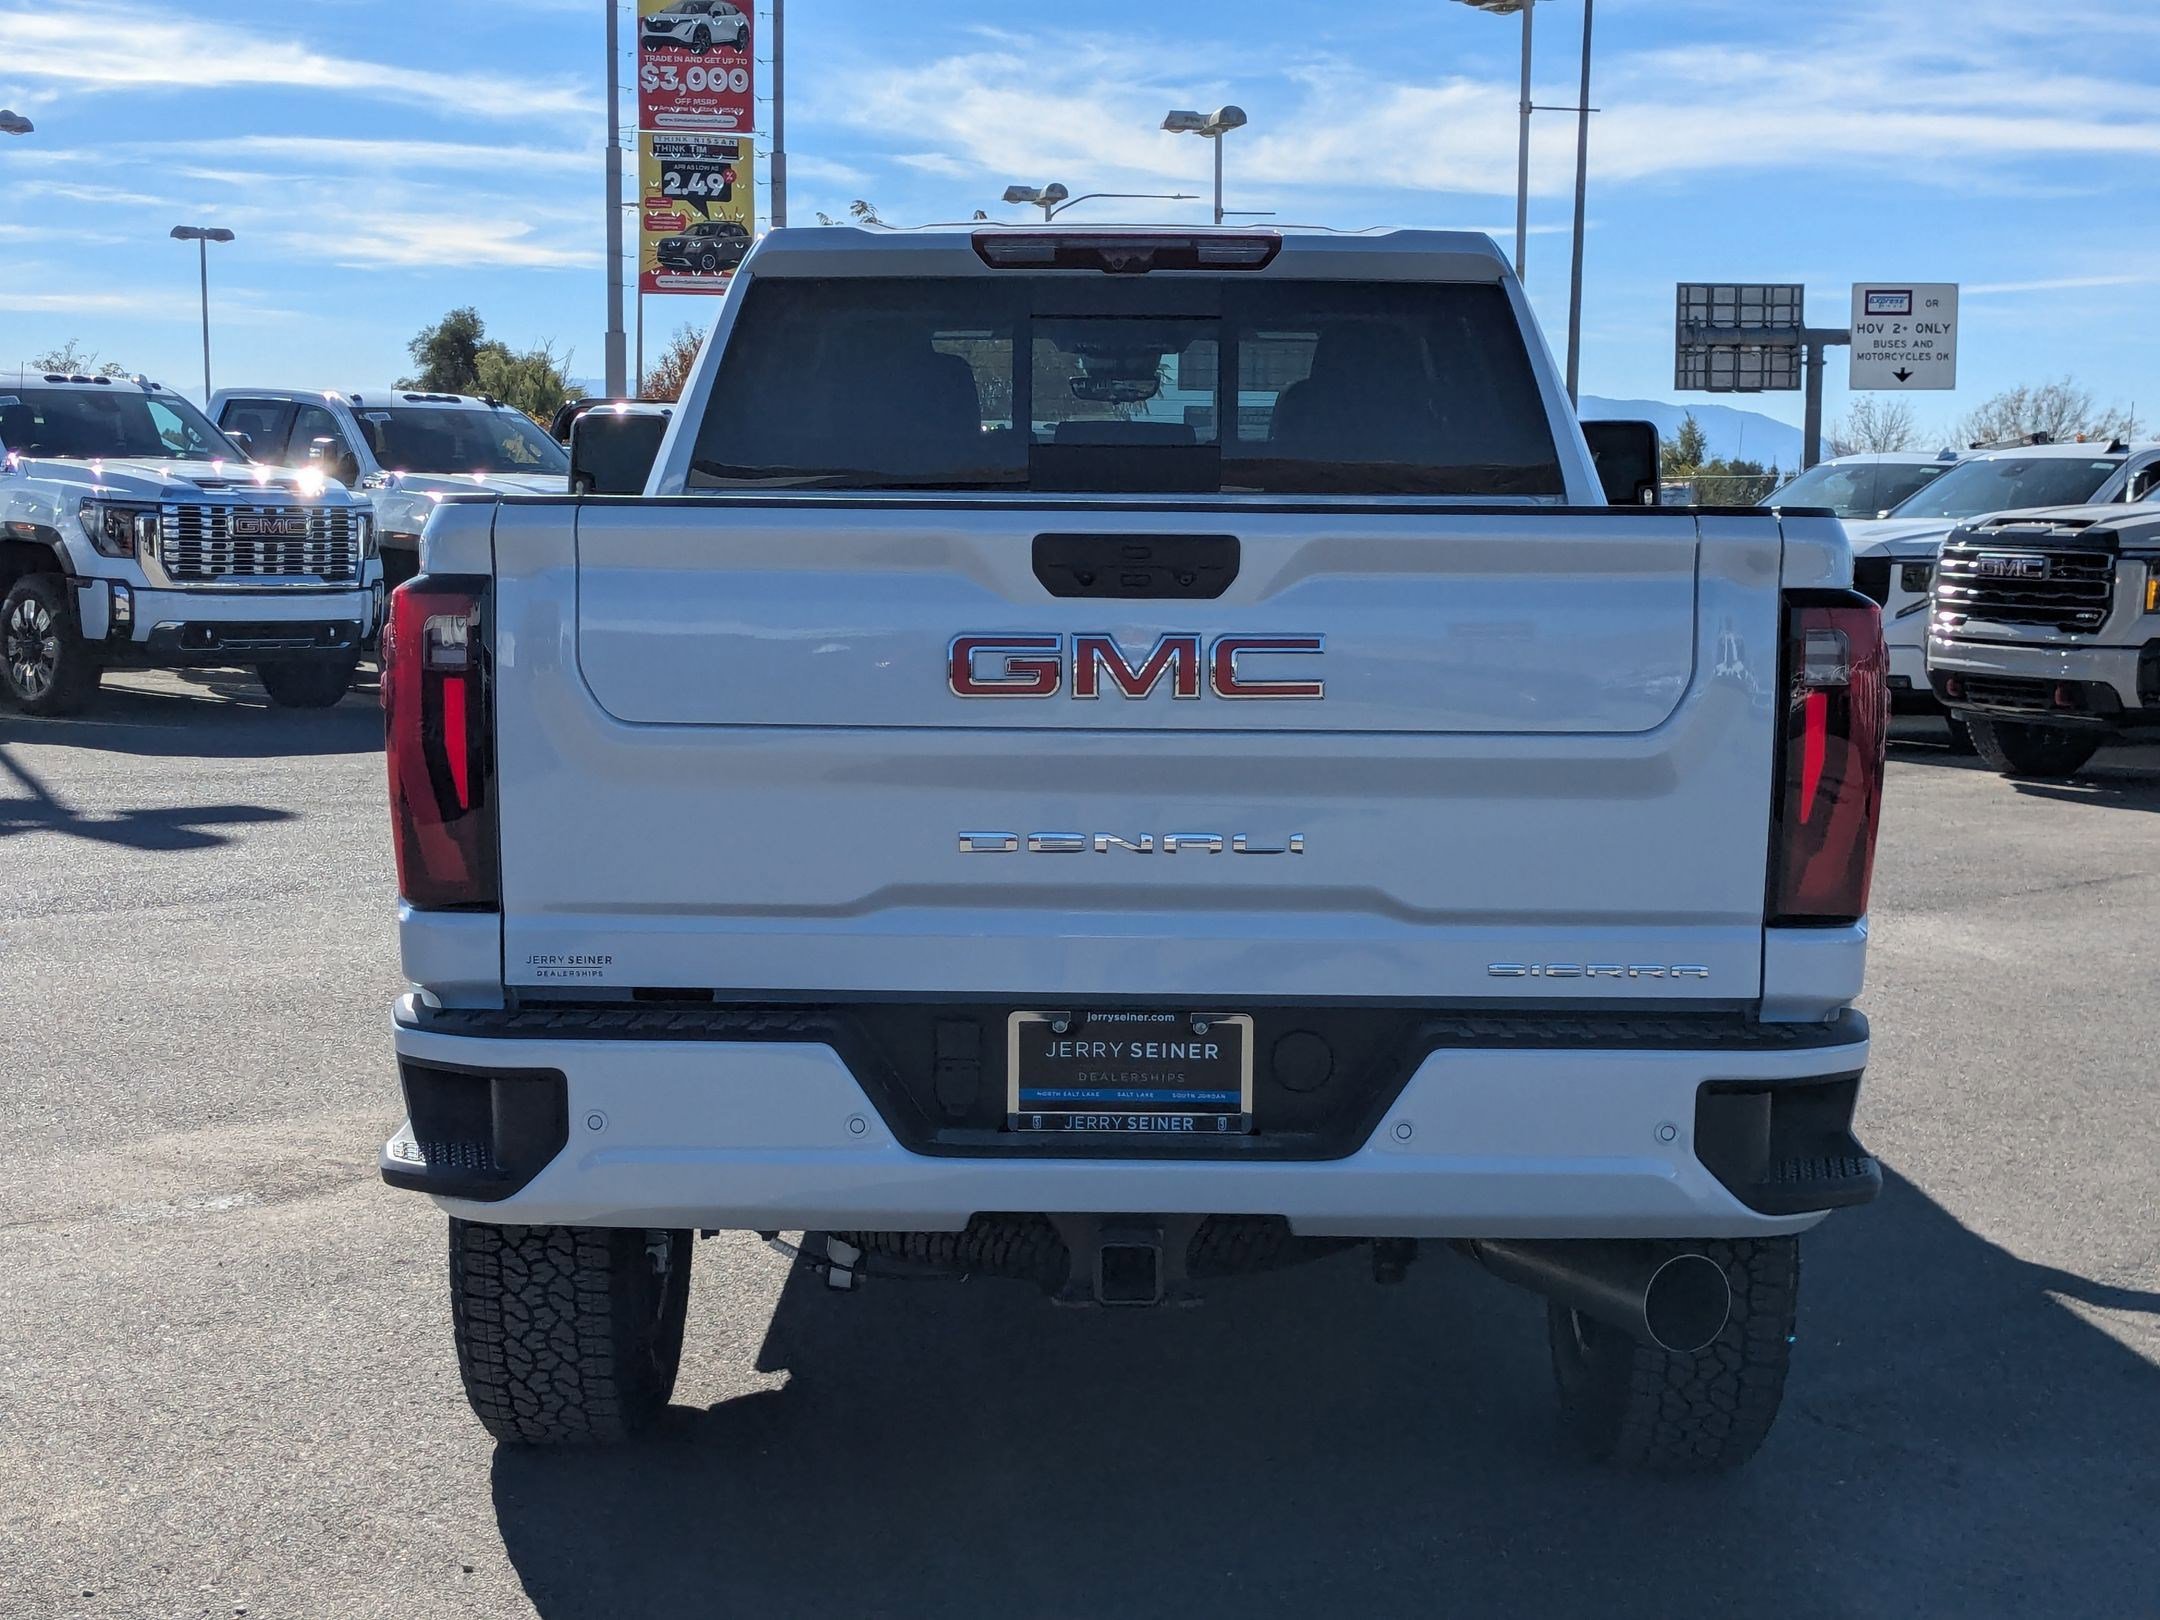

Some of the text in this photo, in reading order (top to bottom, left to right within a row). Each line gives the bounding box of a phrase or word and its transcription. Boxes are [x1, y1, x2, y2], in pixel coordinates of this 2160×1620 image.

[645, 55, 672, 63] TRADE
[685, 56, 702, 64] AND
[723, 57, 734, 65] UP
[641, 62, 749, 96] $3,000
[694, 138, 735, 146] NISSAN
[655, 145, 707, 153] THINK TIM
[1925, 299, 1939, 308] OR
[1856, 323, 1951, 334] HOV 2+ ONLY
[1873, 340, 1934, 349] BUSES AND
[1856, 352, 1950, 361] MOTORCYCLES OK
[235, 518, 307, 534] GMC
[1980, 557, 2043, 578] GMC
[947, 631, 1327, 701] GMC
[958, 831, 1305, 855] DENALI
[525, 955, 613, 965] JERRY SEINER
[1487, 962, 1710, 978] SIERRA
[1086, 1012, 1176, 1024] jerryseiner.com
[1044, 1041, 1219, 1060] JERRY SEINER
[1077, 1072, 1185, 1083] DEALERSHIPS
[1064, 1115, 1194, 1131] JERRY SEINER
